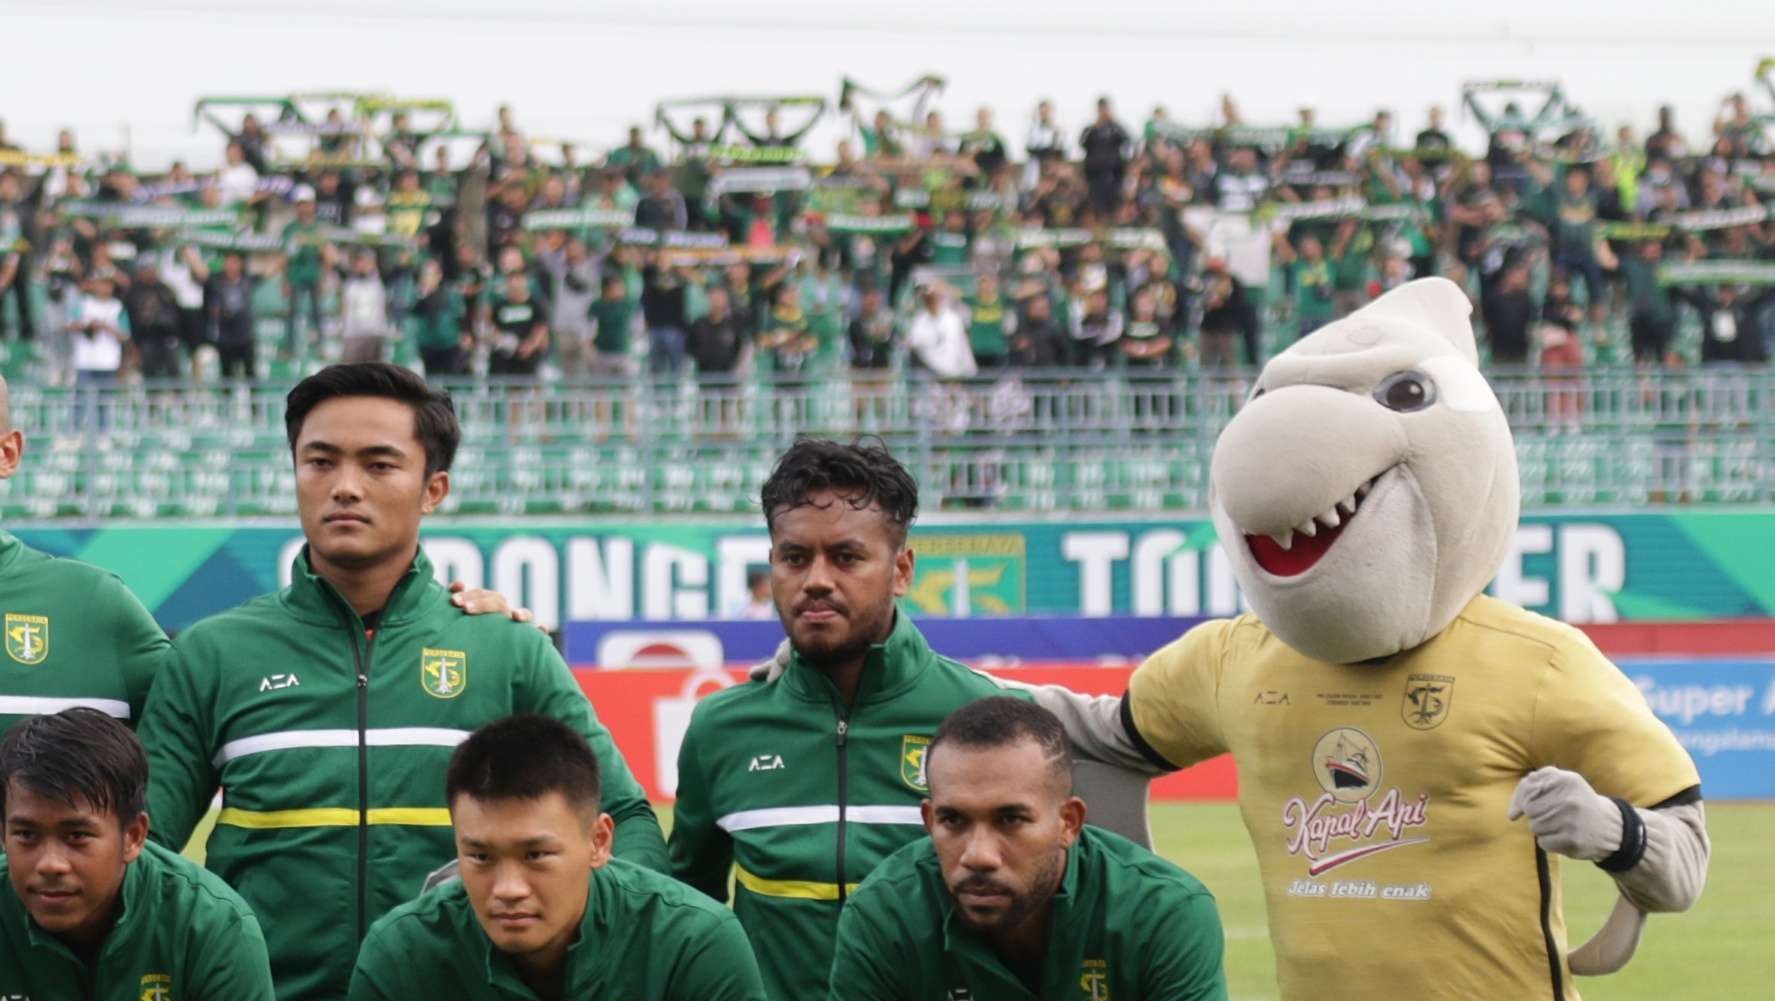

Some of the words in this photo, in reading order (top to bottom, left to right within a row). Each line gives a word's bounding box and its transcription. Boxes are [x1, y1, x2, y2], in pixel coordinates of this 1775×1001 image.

[1284, 792, 1367, 861] Kapal
[1363, 788, 1429, 841] Api
[1288, 880, 1327, 896] Jelas
[1330, 881, 1377, 897] lebih
[1382, 884, 1432, 899] enak
